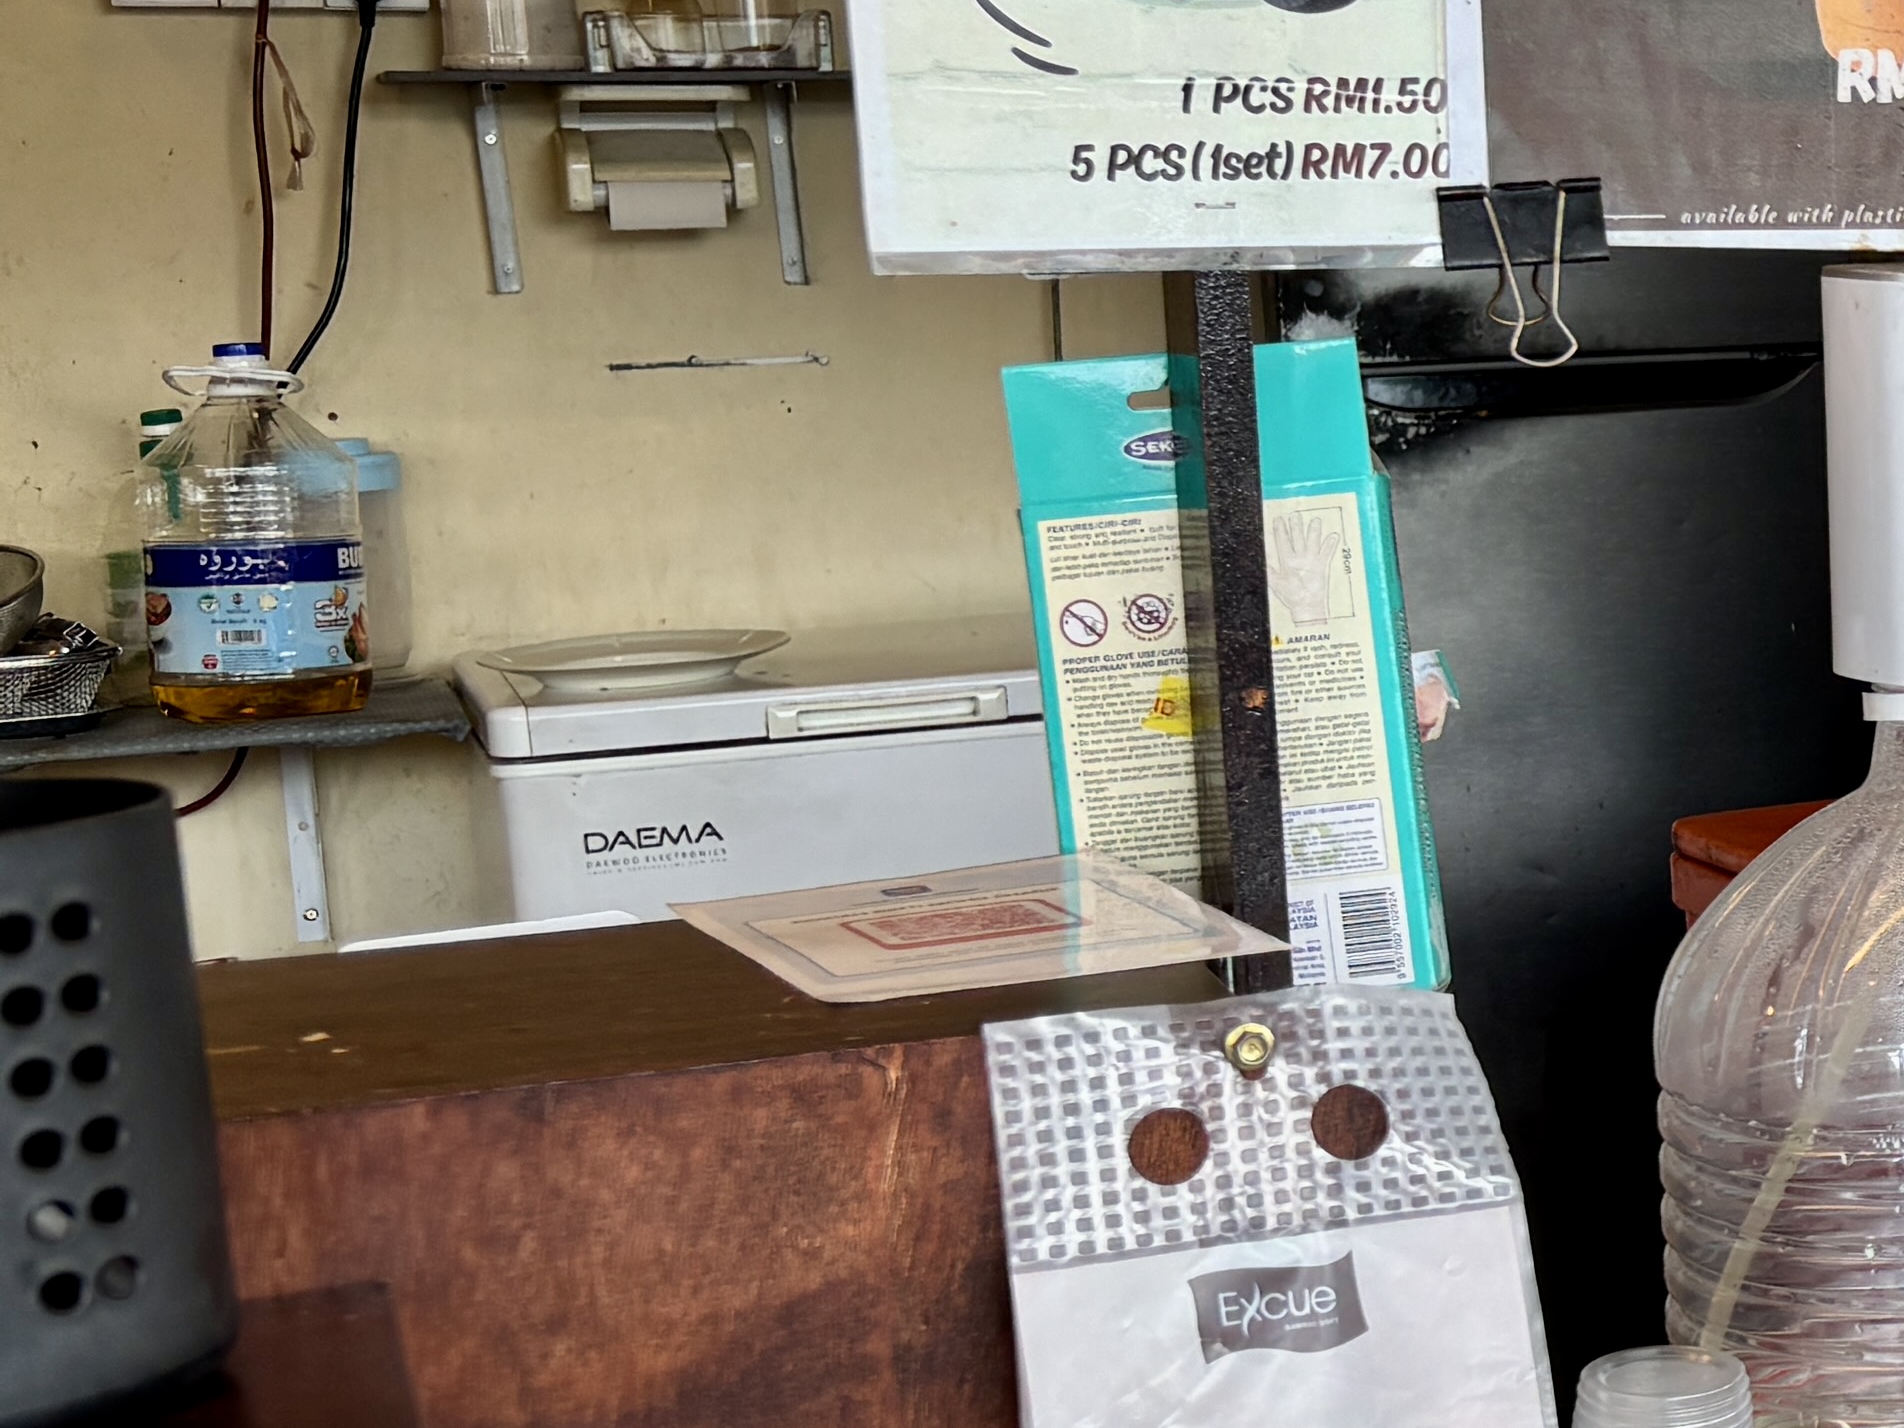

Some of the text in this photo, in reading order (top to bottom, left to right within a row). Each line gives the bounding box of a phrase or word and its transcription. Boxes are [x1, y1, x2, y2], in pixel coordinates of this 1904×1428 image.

[1213, 77, 1294, 115] PCS
[1304, 77, 1448, 116] RM1.50
[1070, 143, 1095, 181] 5
[1301, 142, 1450, 181] RM7.00
[1680, 205, 1778, 225] available
[1787, 205, 1835, 225] with
[1287, 634, 1330, 644] AMARAN
[583, 822, 724, 854] DAEMA
